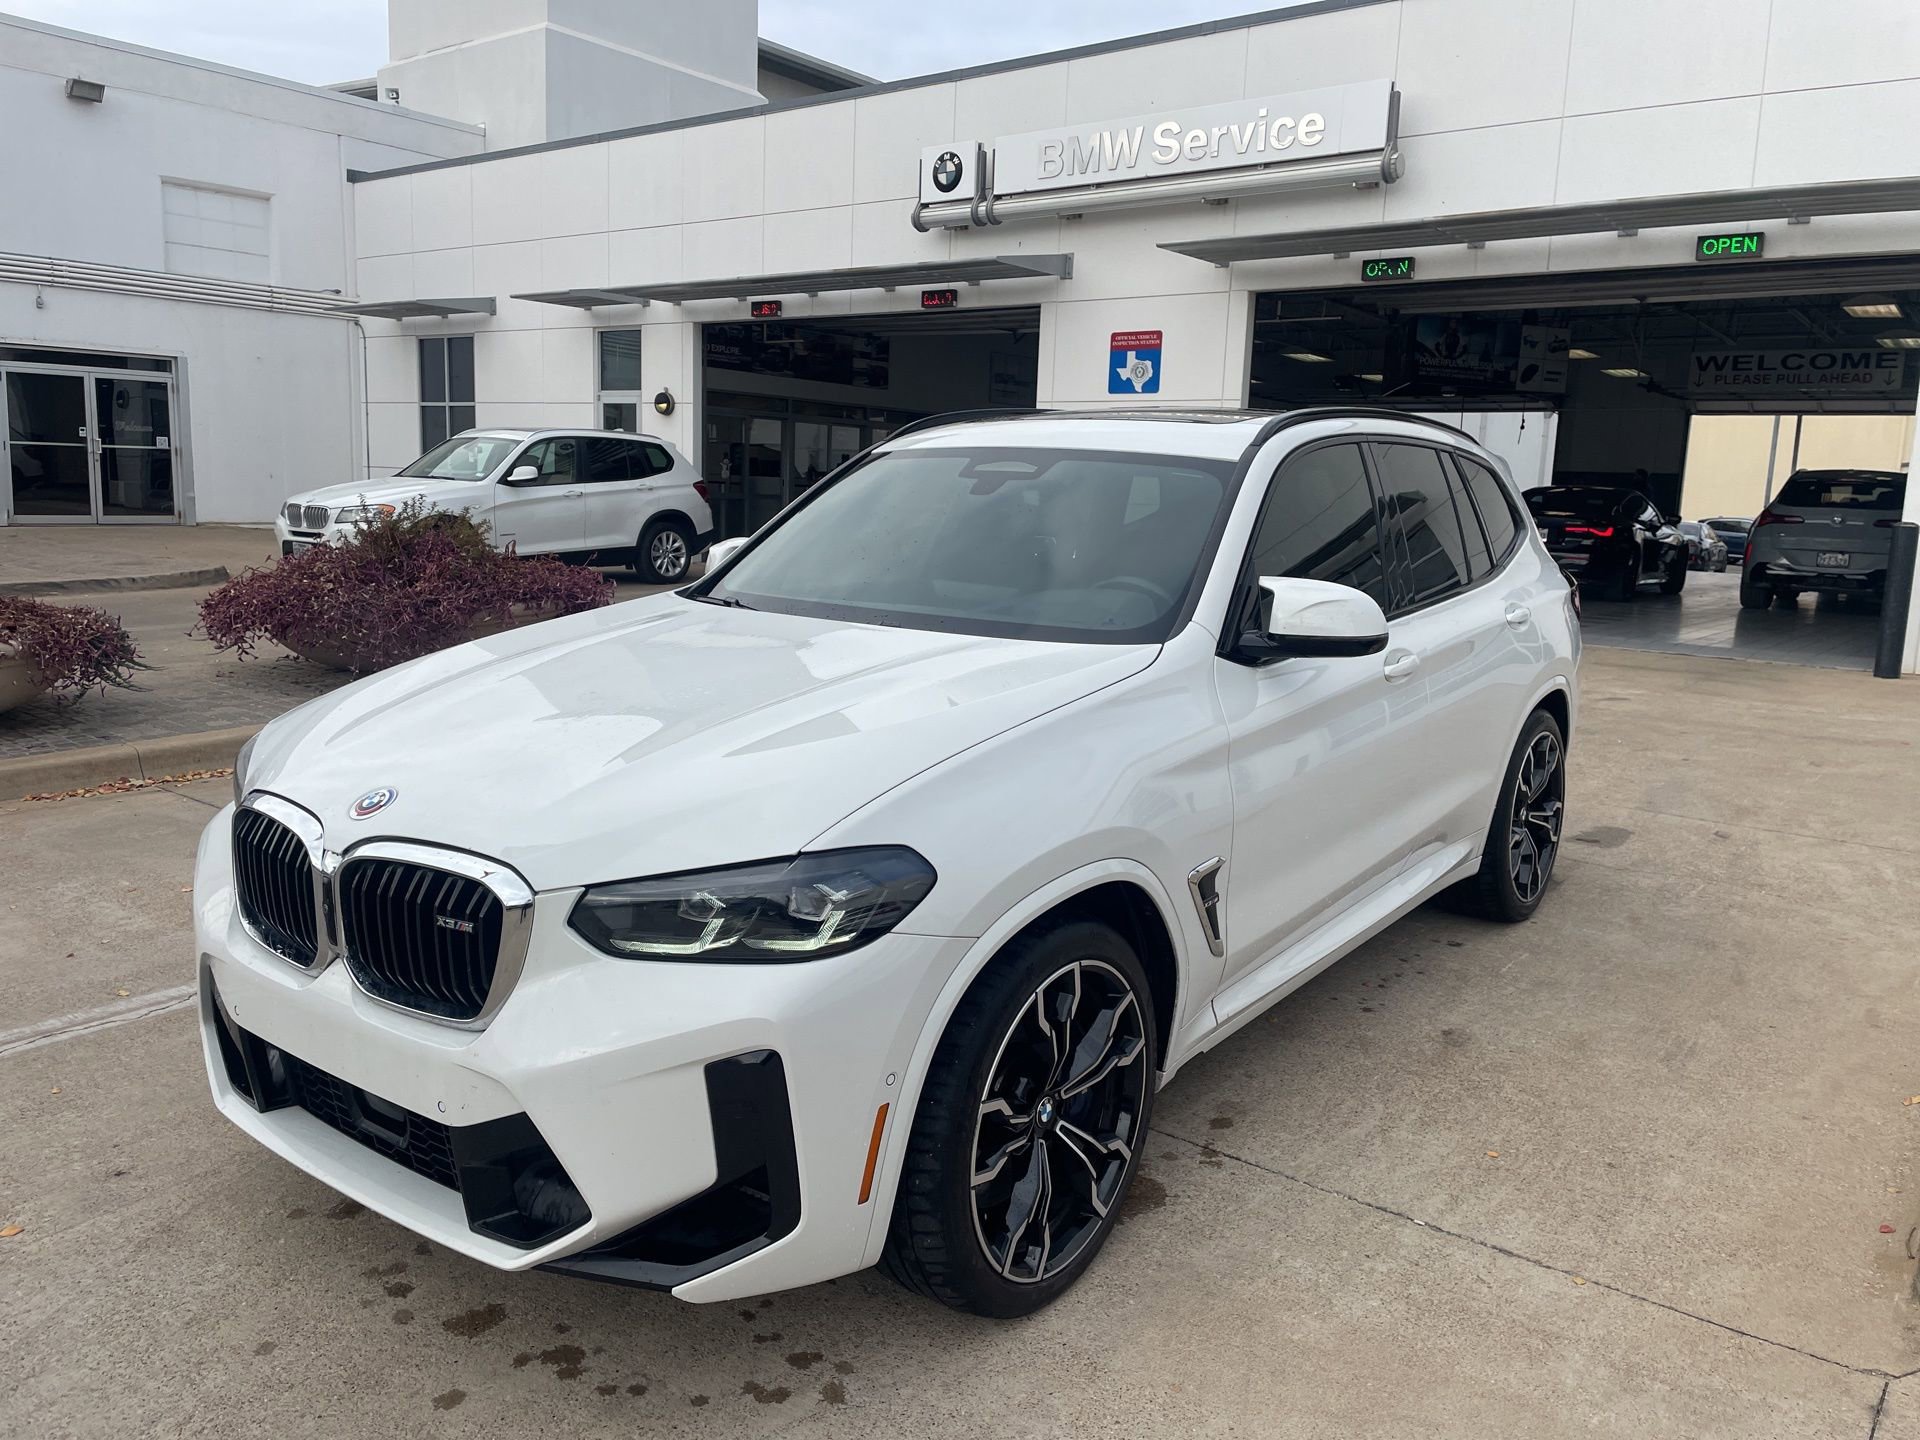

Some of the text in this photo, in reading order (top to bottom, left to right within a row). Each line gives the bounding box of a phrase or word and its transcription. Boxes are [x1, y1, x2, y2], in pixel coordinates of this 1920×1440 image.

[1037, 107, 1326, 180] BMW Service
[935, 152, 961, 168] BMW
[1702, 235, 1758, 255] OPEN
[1695, 352, 1900, 371] WELCOME
[1714, 372, 1873, 385] PLEASE PULL AHEAD
